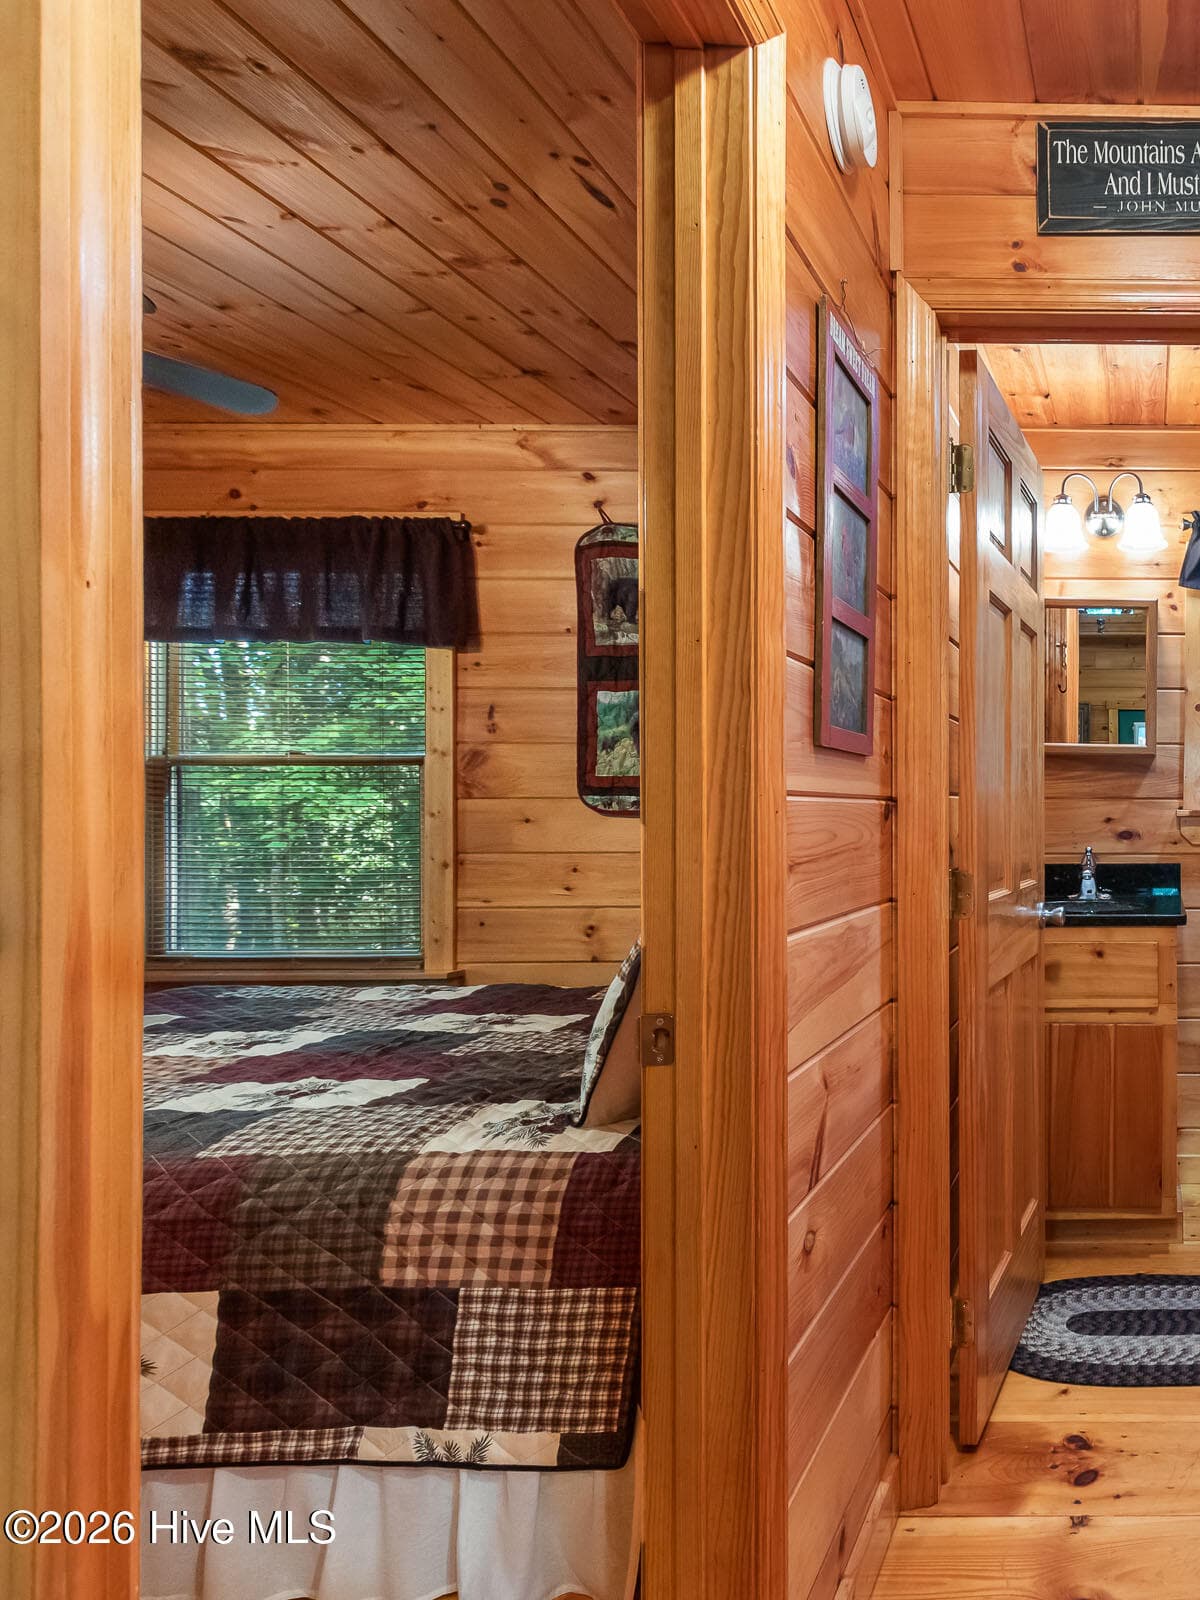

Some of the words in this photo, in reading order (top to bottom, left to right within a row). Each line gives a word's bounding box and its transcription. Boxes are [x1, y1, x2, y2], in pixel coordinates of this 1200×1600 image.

[1053, 139, 1089, 165] The
[1093, 139, 1185, 165] Mountains
[1103, 171, 1141, 196] And
[1147, 172, 1152, 196] I
[1157, 172, 1200, 196] Must
[1116, 200, 1166, 213] JOHN
